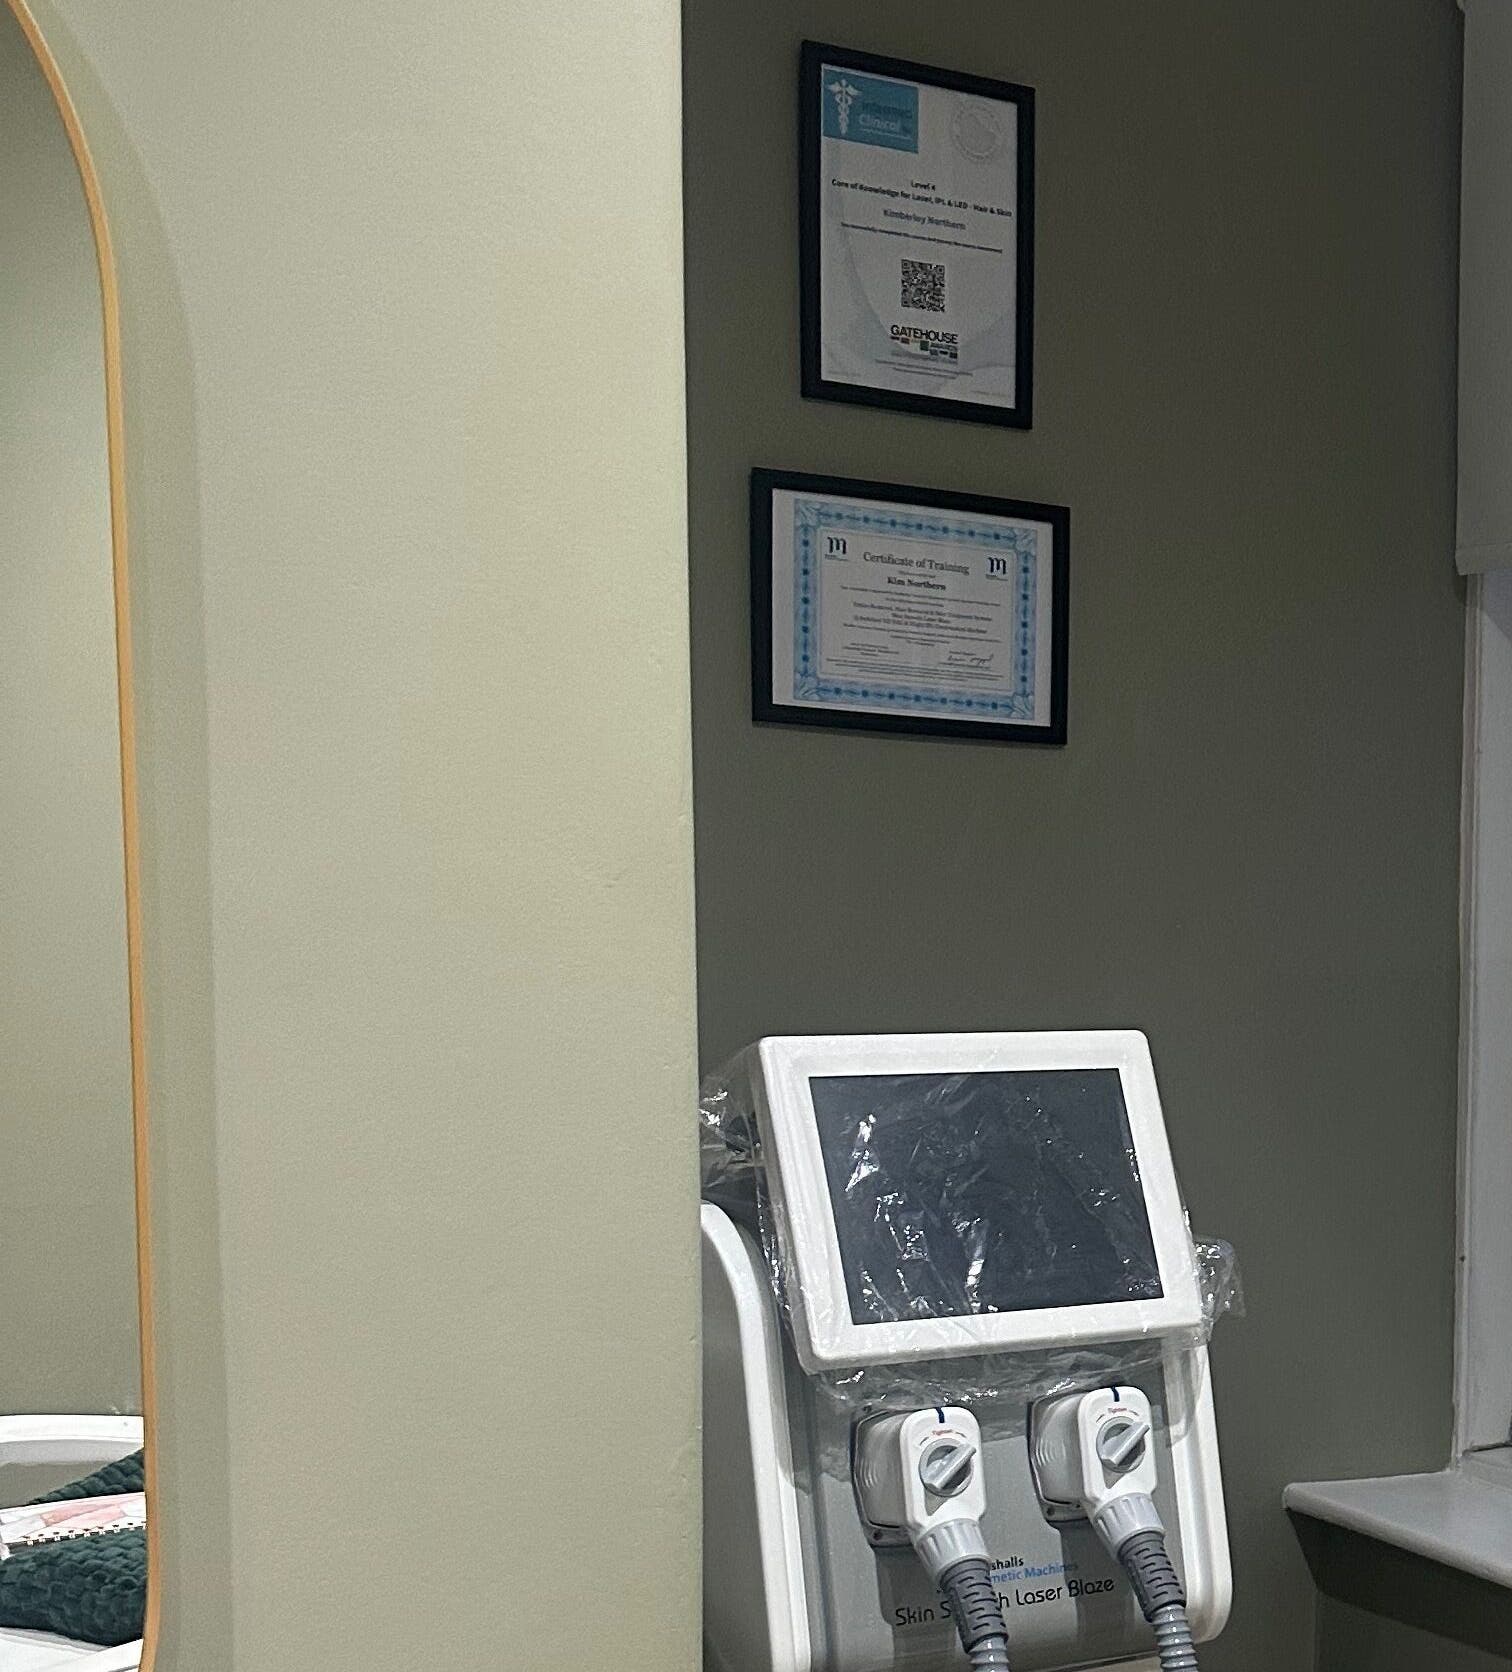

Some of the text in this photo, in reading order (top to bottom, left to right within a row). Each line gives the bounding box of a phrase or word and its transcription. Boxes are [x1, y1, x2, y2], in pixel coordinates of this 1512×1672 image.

[831, 178, 849, 189] Core
[850, 182, 858, 190] of
[883, 208, 926, 224] Kimberley
[890, 324, 959, 345] GATEHOUSE
[863, 551, 914, 567] Certificate
[915, 557, 926, 568] of
[927, 559, 970, 576] Training
[887, 576, 946, 591] Kim Northern
[991, 1556, 1024, 1571] shalls
[992, 1571, 1023, 1583] metic
[895, 1606, 935, 1626] Skin
[1015, 1586, 1063, 1606] Laser
[1068, 1578, 1114, 1598] Blaze
